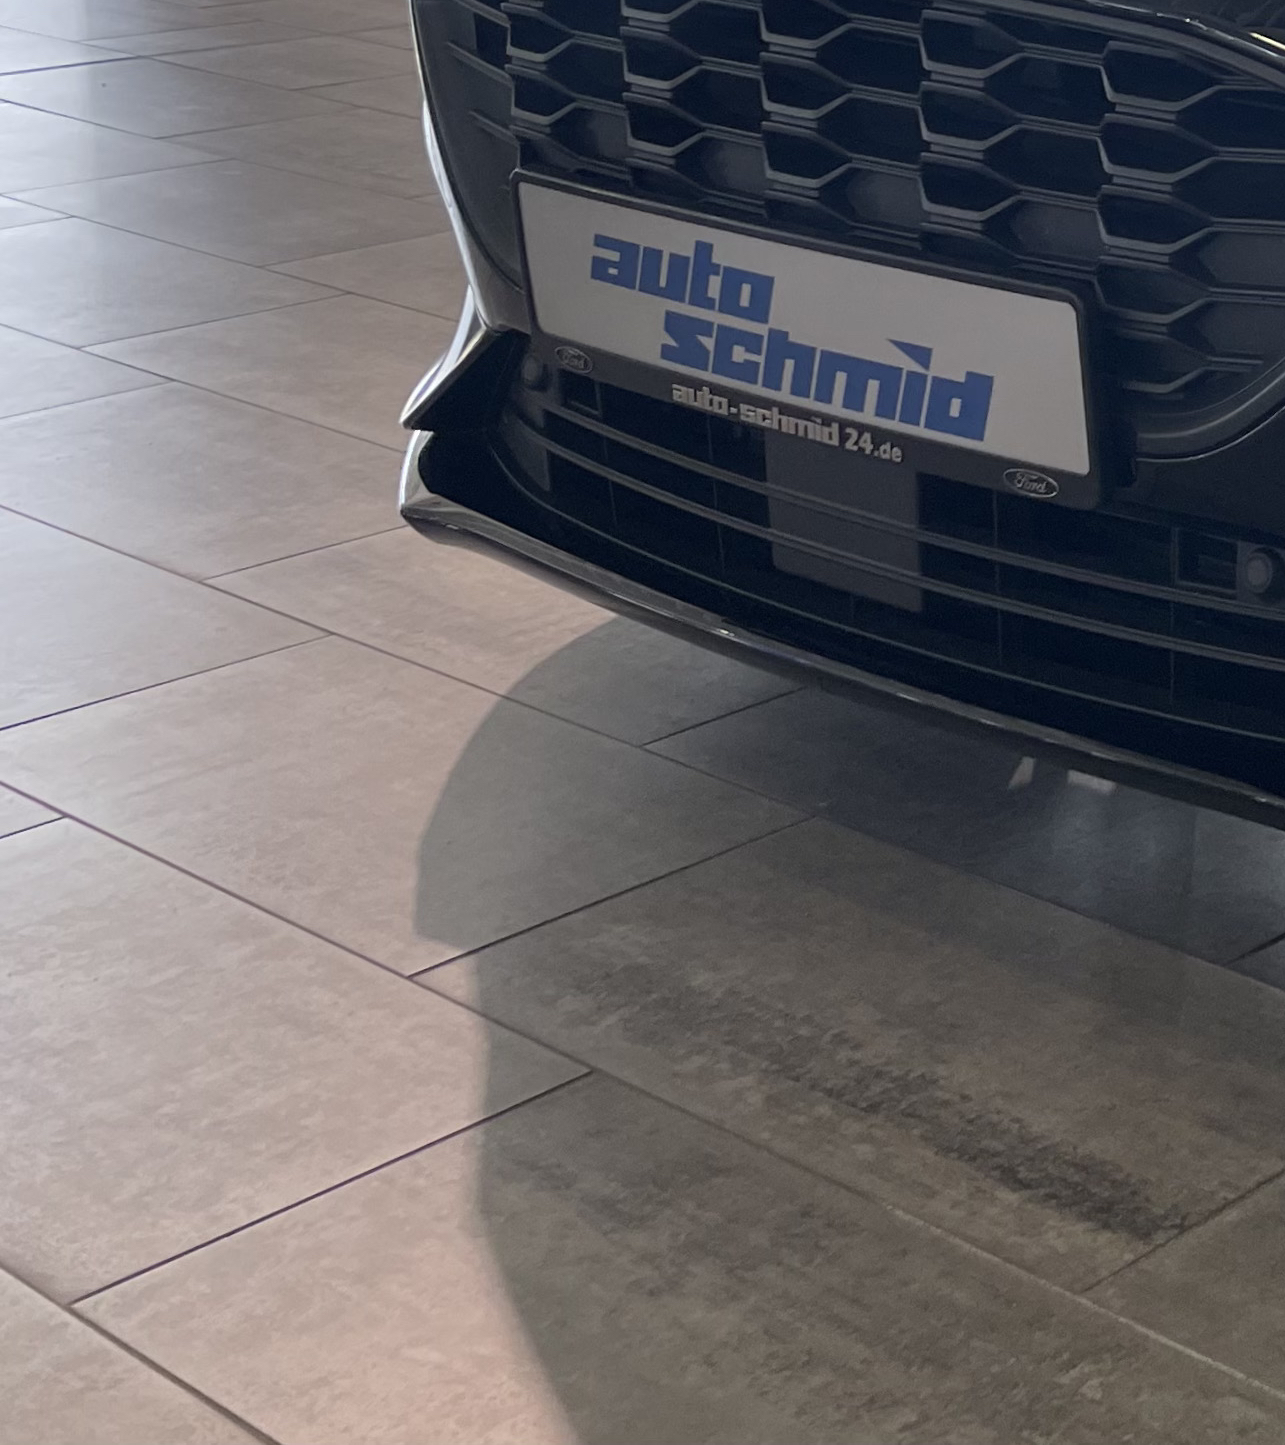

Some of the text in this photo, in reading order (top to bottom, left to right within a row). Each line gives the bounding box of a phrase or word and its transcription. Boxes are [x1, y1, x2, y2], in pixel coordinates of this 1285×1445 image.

[590, 233, 775, 324] auto
[660, 310, 994, 442] schmid
[1015, 472, 1048, 493] Ford
